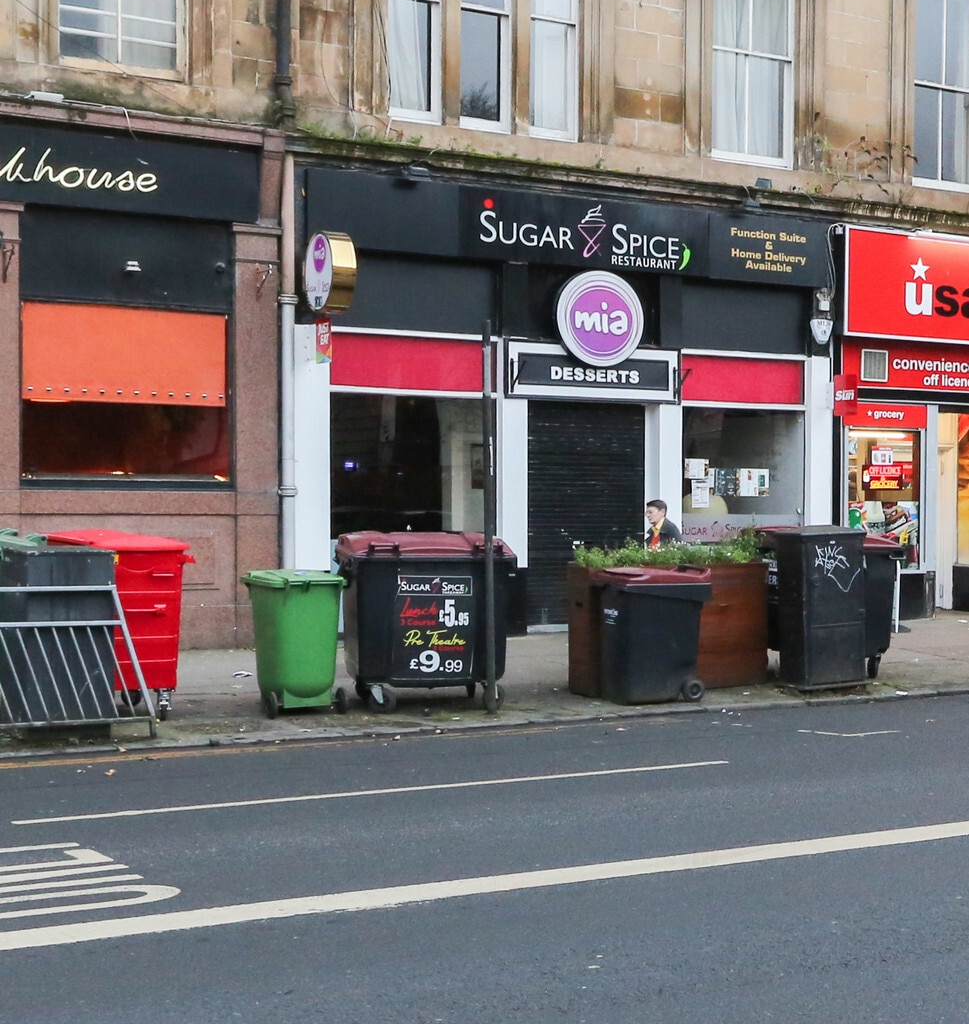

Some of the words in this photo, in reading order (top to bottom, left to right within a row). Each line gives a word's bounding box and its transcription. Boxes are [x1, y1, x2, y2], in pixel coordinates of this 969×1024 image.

[479, 209, 574, 250] SUGAR
[611, 223, 680, 260] SPICE
[730, 226, 776, 240] Function
[779, 232, 807, 244] Suite
[765, 240, 773, 250] &
[611, 254, 677, 270] RESTAURANT
[731, 248, 762, 260] Home
[764, 251, 807, 266] Delivery
[745, 259, 793, 273] Available
[574, 301, 629, 336] mia
[550, 365, 640, 384] DESSERTS
[923, 374, 941, 386] off
[873, 410, 905, 421] grocery
[400, 580, 431, 591] SUGAR
[441, 581, 465, 592] SPICE
[400, 596, 438, 618] Lunch
[438, 598, 470, 628] £5.95
[403, 629, 425, 647] Pre
[426, 629, 467, 648] Theatre
[409, 649, 463, 673] £9.99
